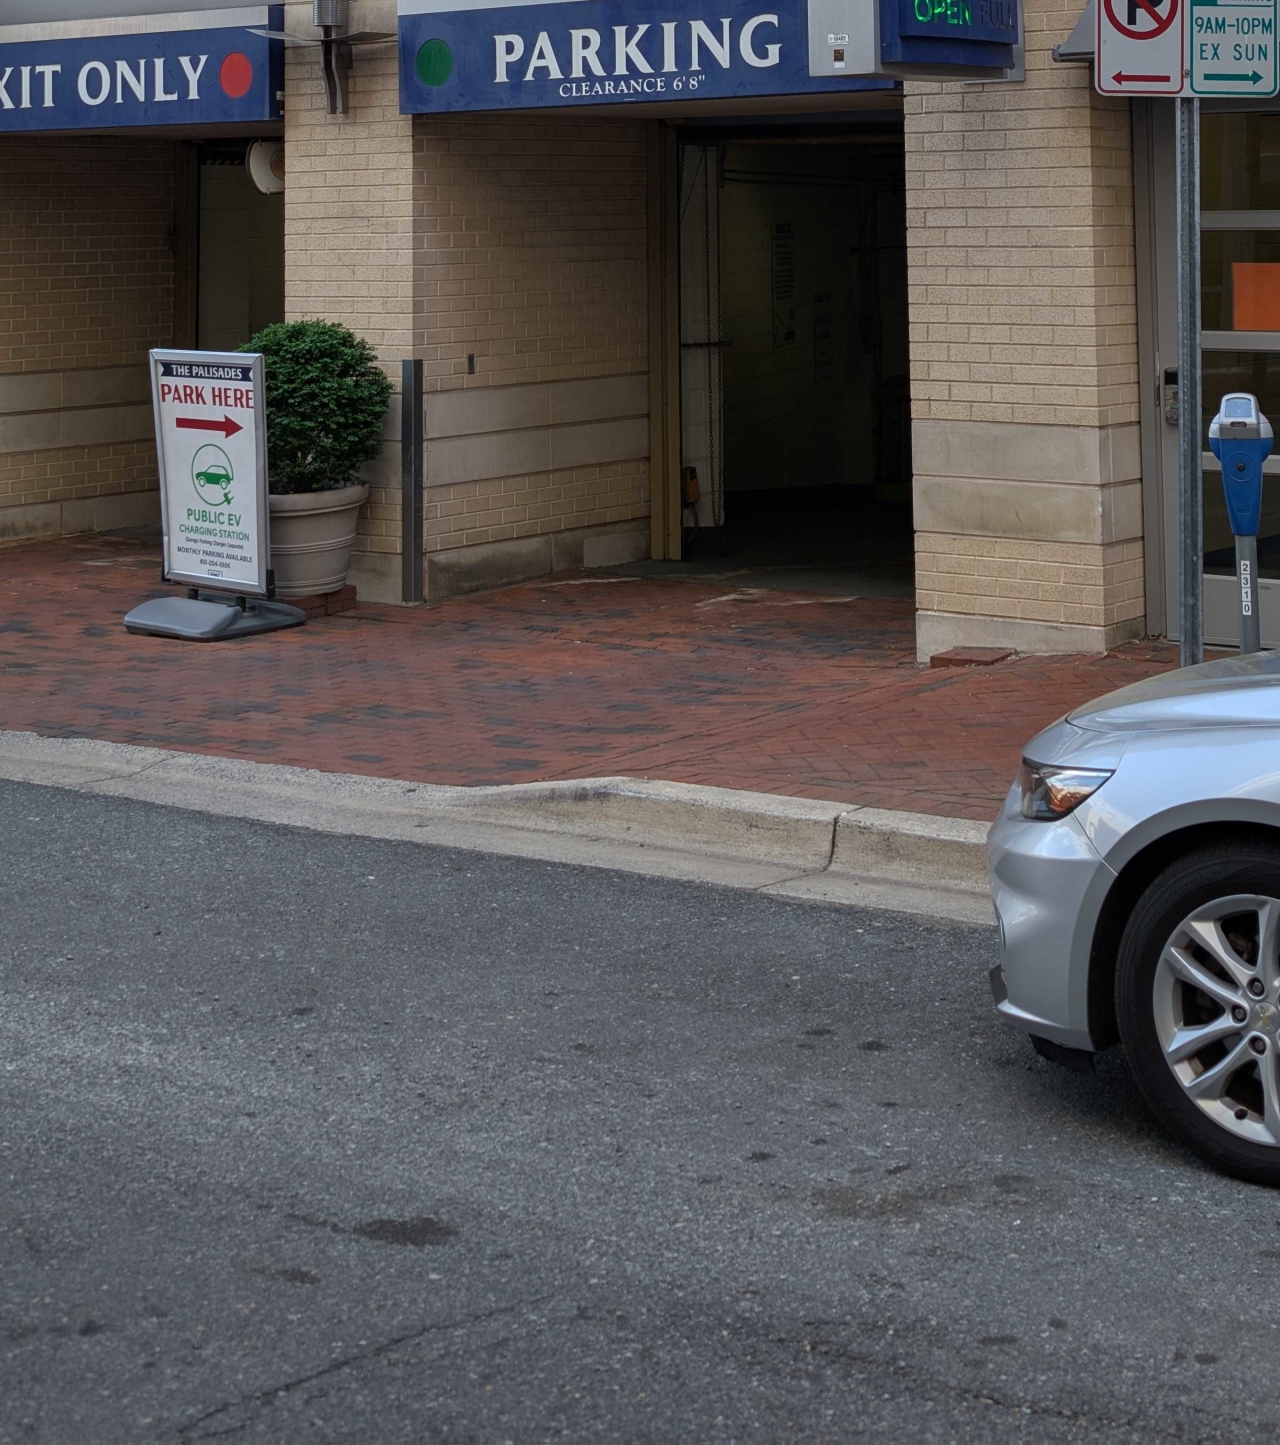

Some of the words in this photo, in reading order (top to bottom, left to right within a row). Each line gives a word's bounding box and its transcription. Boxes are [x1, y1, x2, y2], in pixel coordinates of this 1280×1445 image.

[1194, 16, 1273, 35] 9AM-10PM
[492, 13, 783, 83] PARKING
[1199, 42, 1221, 61] EX
[1233, 43, 1268, 62] SUN
[77, 54, 210, 106] ONLY
[559, 77, 667, 98] CLEARANCE
[171, 364, 191, 376] THE
[192, 365, 243, 380] PALISADES
[160, 383, 207, 406] PARK
[211, 386, 255, 409] HERE
[186, 507, 226, 525] PUBLIC
[227, 513, 242, 527] EV
[179, 523, 218, 538] CHARGING
[219, 529, 250, 542] STATION
[177, 545, 202, 556] MONTHLY
[202, 549, 225, 559] PARKING
[225, 552, 253, 564] AVAILABLE
[1242, 562, 1251, 614] 2310
